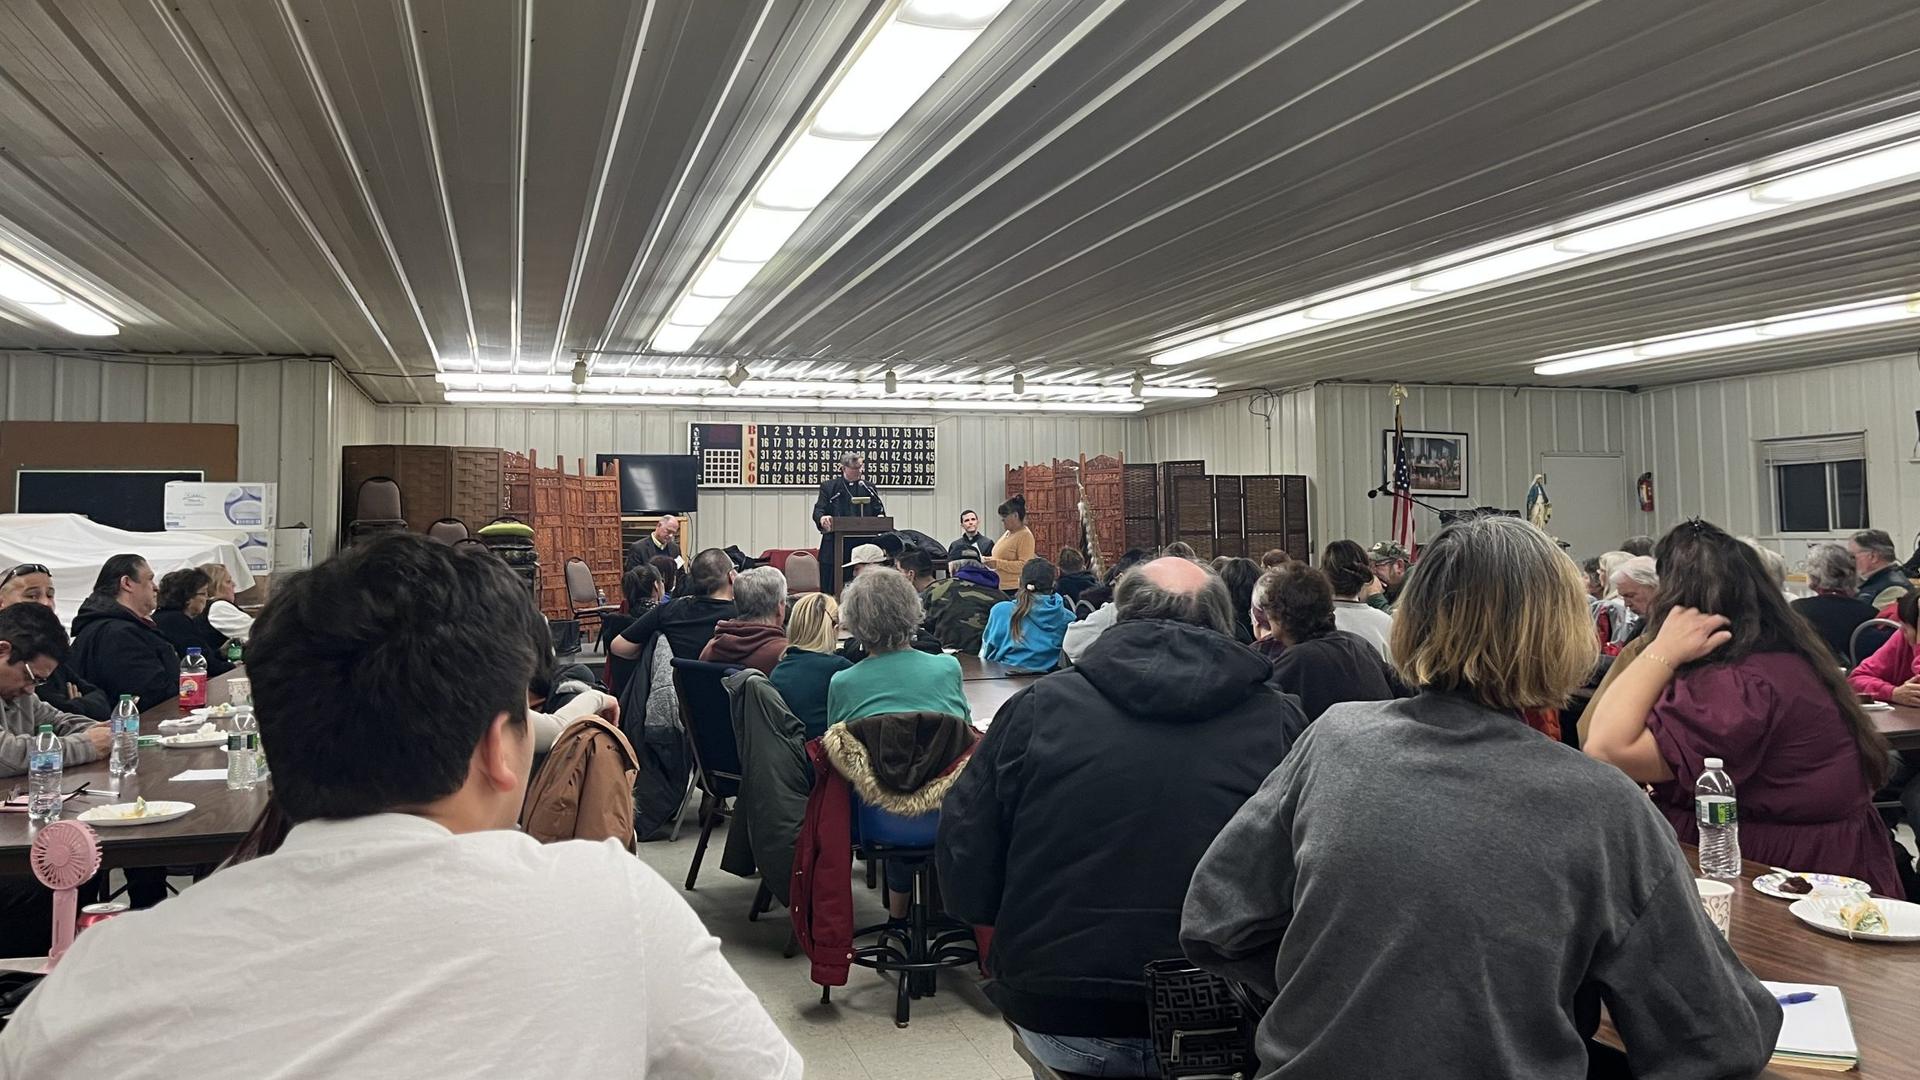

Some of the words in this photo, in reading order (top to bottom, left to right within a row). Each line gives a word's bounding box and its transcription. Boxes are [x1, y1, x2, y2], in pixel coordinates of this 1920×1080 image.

[763, 426, 767, 436] 1
[774, 426, 780, 436] 2
[787, 426, 792, 436] 3
[799, 426, 804, 436] 4
[811, 426, 816, 436] 5
[823, 426, 828, 437] 6
[835, 426, 840, 437] 7
[846, 427, 851, 437] 8
[858, 427, 863, 437] 9
[868, 427, 876, 437] 10
[881, 427, 887, 437] 11
[892, 427, 899, 437] 12
[904, 427, 911, 438] 13
[915, 427, 922, 438] 14
[927, 428, 935, 438] 15
[761, 438, 769, 448] 16
[773, 438, 781, 448] 17
[786, 438, 793, 448] 18
[798, 438, 805, 448] 19
[809, 438, 818, 448] 20
[822, 438, 829, 449] 21
[833, 438, 841, 449] 22
[845, 439, 853, 449] 23
[856, 439, 865, 449] 24
[868, 439, 876, 449] 25
[880, 439, 888, 449] 26
[891, 439, 900, 449] 27
[903, 439, 911, 450] 28
[915, 439, 923, 450] 29
[926, 440, 935, 450] 30
[748, 425, 756, 484] BINGO
[761, 450, 769, 460] 31
[773, 450, 781, 460] 32
[785, 450, 794, 460] 33
[797, 450, 805, 460] 34
[809, 450, 818, 461] 35
[821, 450, 830, 461] 36
[833, 451, 842, 461] 37
[868, 451, 877, 461] 40
[880, 451, 888, 461] 41
[892, 451, 900, 461] 42
[903, 451, 911, 462] 43
[915, 451, 923, 462] 44
[926, 452, 935, 462] 45
[760, 462, 769, 472] 46
[772, 462, 781, 472] 47
[785, 462, 794, 472] 48
[797, 462, 806, 472] 49
[809, 462, 818, 472] 50
[822, 462, 829, 473] 51
[833, 462, 842, 473] 52
[868, 463, 877, 473] 55
[880, 463, 888, 473] 56
[892, 463, 900, 473] 57
[903, 463, 911, 473] 58
[915, 463, 923, 473] 59
[926, 463, 935, 474] 60
[760, 474, 768, 484] 61
[772, 474, 781, 484] 62
[785, 474, 794, 484] 63
[797, 474, 806, 484] 64
[809, 474, 818, 484] 65
[868, 475, 877, 485] 70
[880, 475, 888, 485] 71
[892, 475, 900, 485] 72
[903, 475, 911, 485] 73
[915, 475, 923, 485] 74
[926, 475, 935, 485] 75
